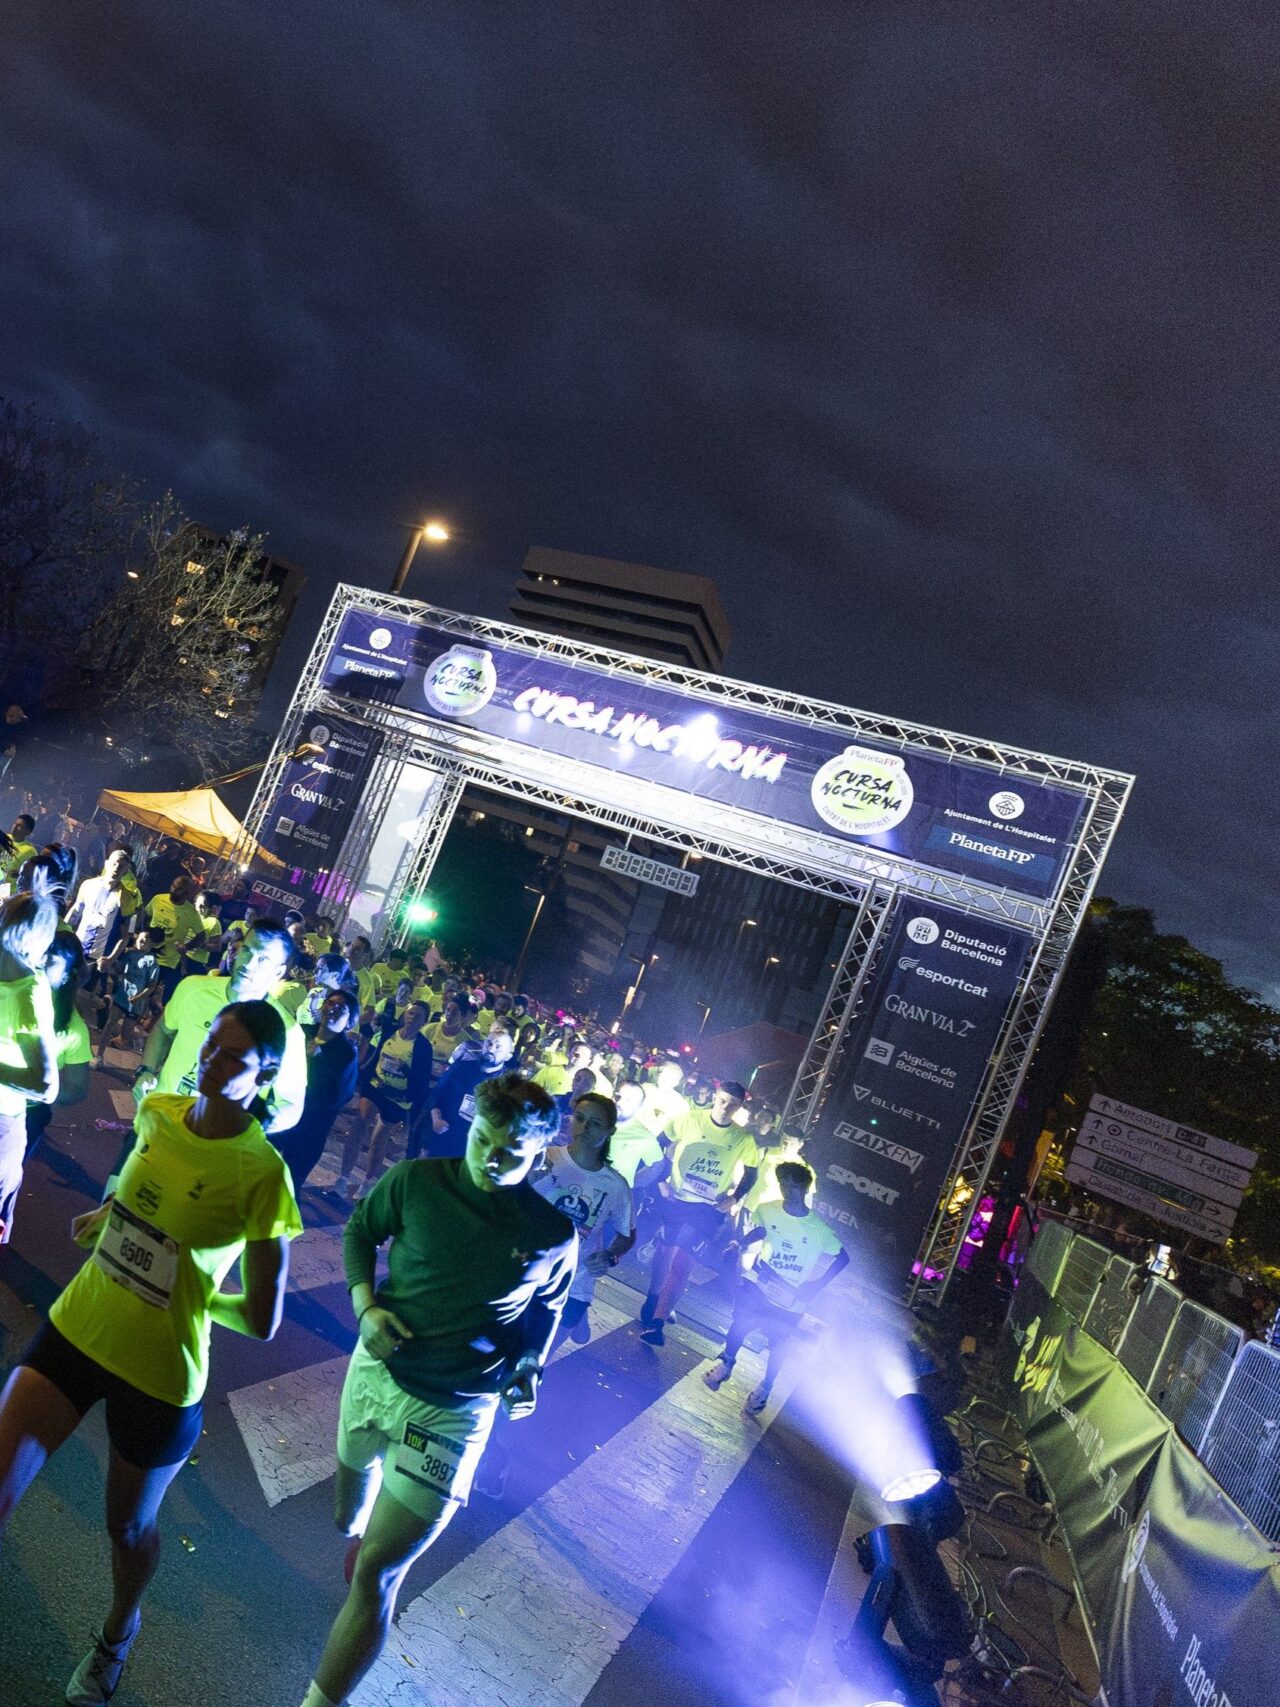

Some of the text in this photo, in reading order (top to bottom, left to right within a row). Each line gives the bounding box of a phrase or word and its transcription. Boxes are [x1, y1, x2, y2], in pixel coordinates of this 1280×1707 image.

[441, 663, 484, 682] CURSA
[514, 687, 615, 735] CURSA
[850, 749, 898, 768] PlanetaFP
[291, 783, 318, 804] GRAN
[820, 782, 902, 812] NOCTURNA
[834, 770, 894, 793] CURSA
[944, 808, 1056, 844] Ajuntament de L'Hospitalet
[948, 832, 1033, 865] PlanetaFP
[940, 938, 1004, 968] Barcelona
[944, 928, 1008, 958] Diputació
[915, 963, 989, 999] esportcat
[884, 992, 928, 1026] GRAN
[926, 1010, 956, 1034] VIA
[894, 1058, 956, 1090] Barcelona
[898, 1048, 958, 1078] Aigües de
[870, 1095, 942, 1130] BLUETTI
[825, 1164, 900, 1206] SPORT
[119, 1236, 155, 1273] 8506
[406, 1432, 425, 1451] 10K
[421, 1454, 458, 1485] 3897
